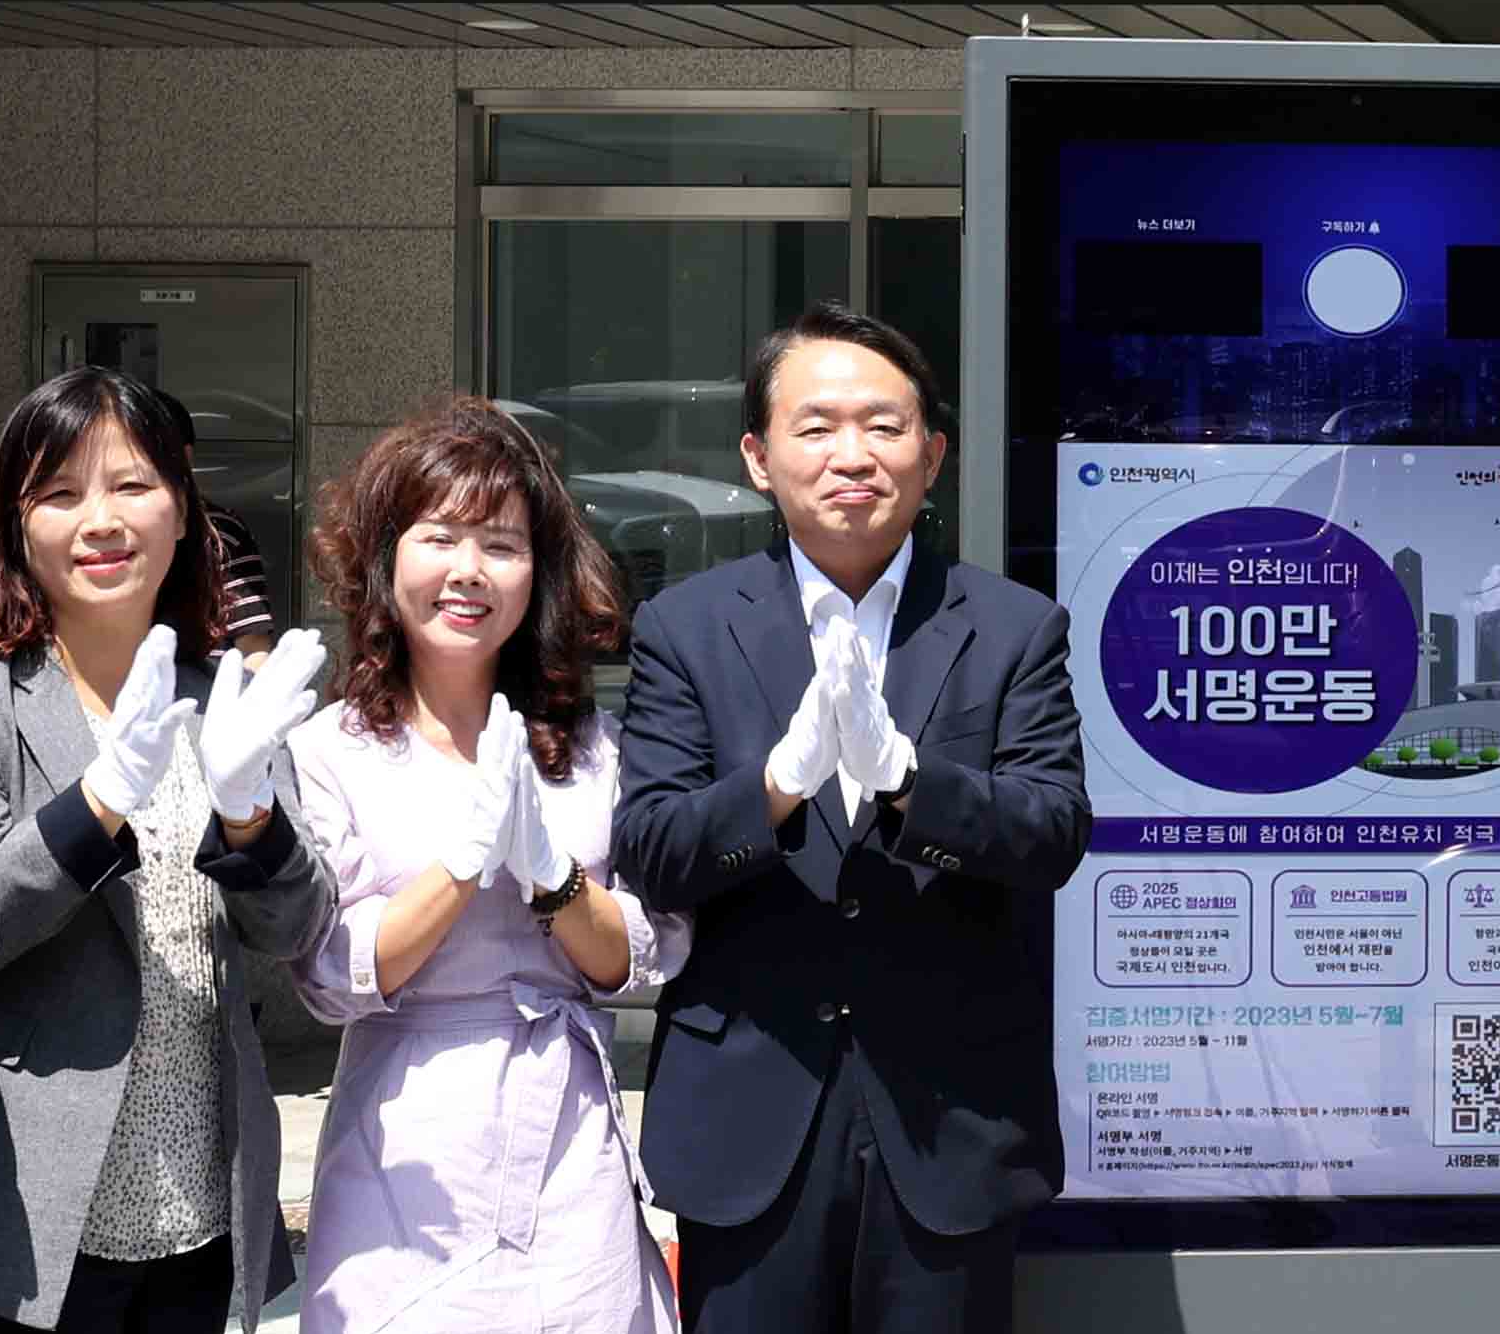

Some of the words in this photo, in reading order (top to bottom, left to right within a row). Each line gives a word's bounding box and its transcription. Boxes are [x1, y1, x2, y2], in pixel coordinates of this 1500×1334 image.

[1109, 467, 1195, 483] 인천광역시
[1151, 562, 1220, 584] 이제는
[1228, 559, 1358, 587] 인천입니다!
[1170, 605, 1338, 657] 100만
[1143, 669, 1376, 723] 서명운동
[1140, 825, 1247, 844] 서명운동에
[1259, 825, 1346, 844] 참여하여
[1357, 825, 1441, 844] 인천유치
[1453, 825, 1494, 844] 적극
[1143, 883, 1178, 895] 2025
[1143, 896, 1181, 909] APEC
[1116, 960, 1167, 974] 국제도시
[1234, 1005, 1312, 1026] 2023년
[1143, 1035, 1186, 1048] 2023년
[1086, 1061, 1172, 1083] 참여방법
